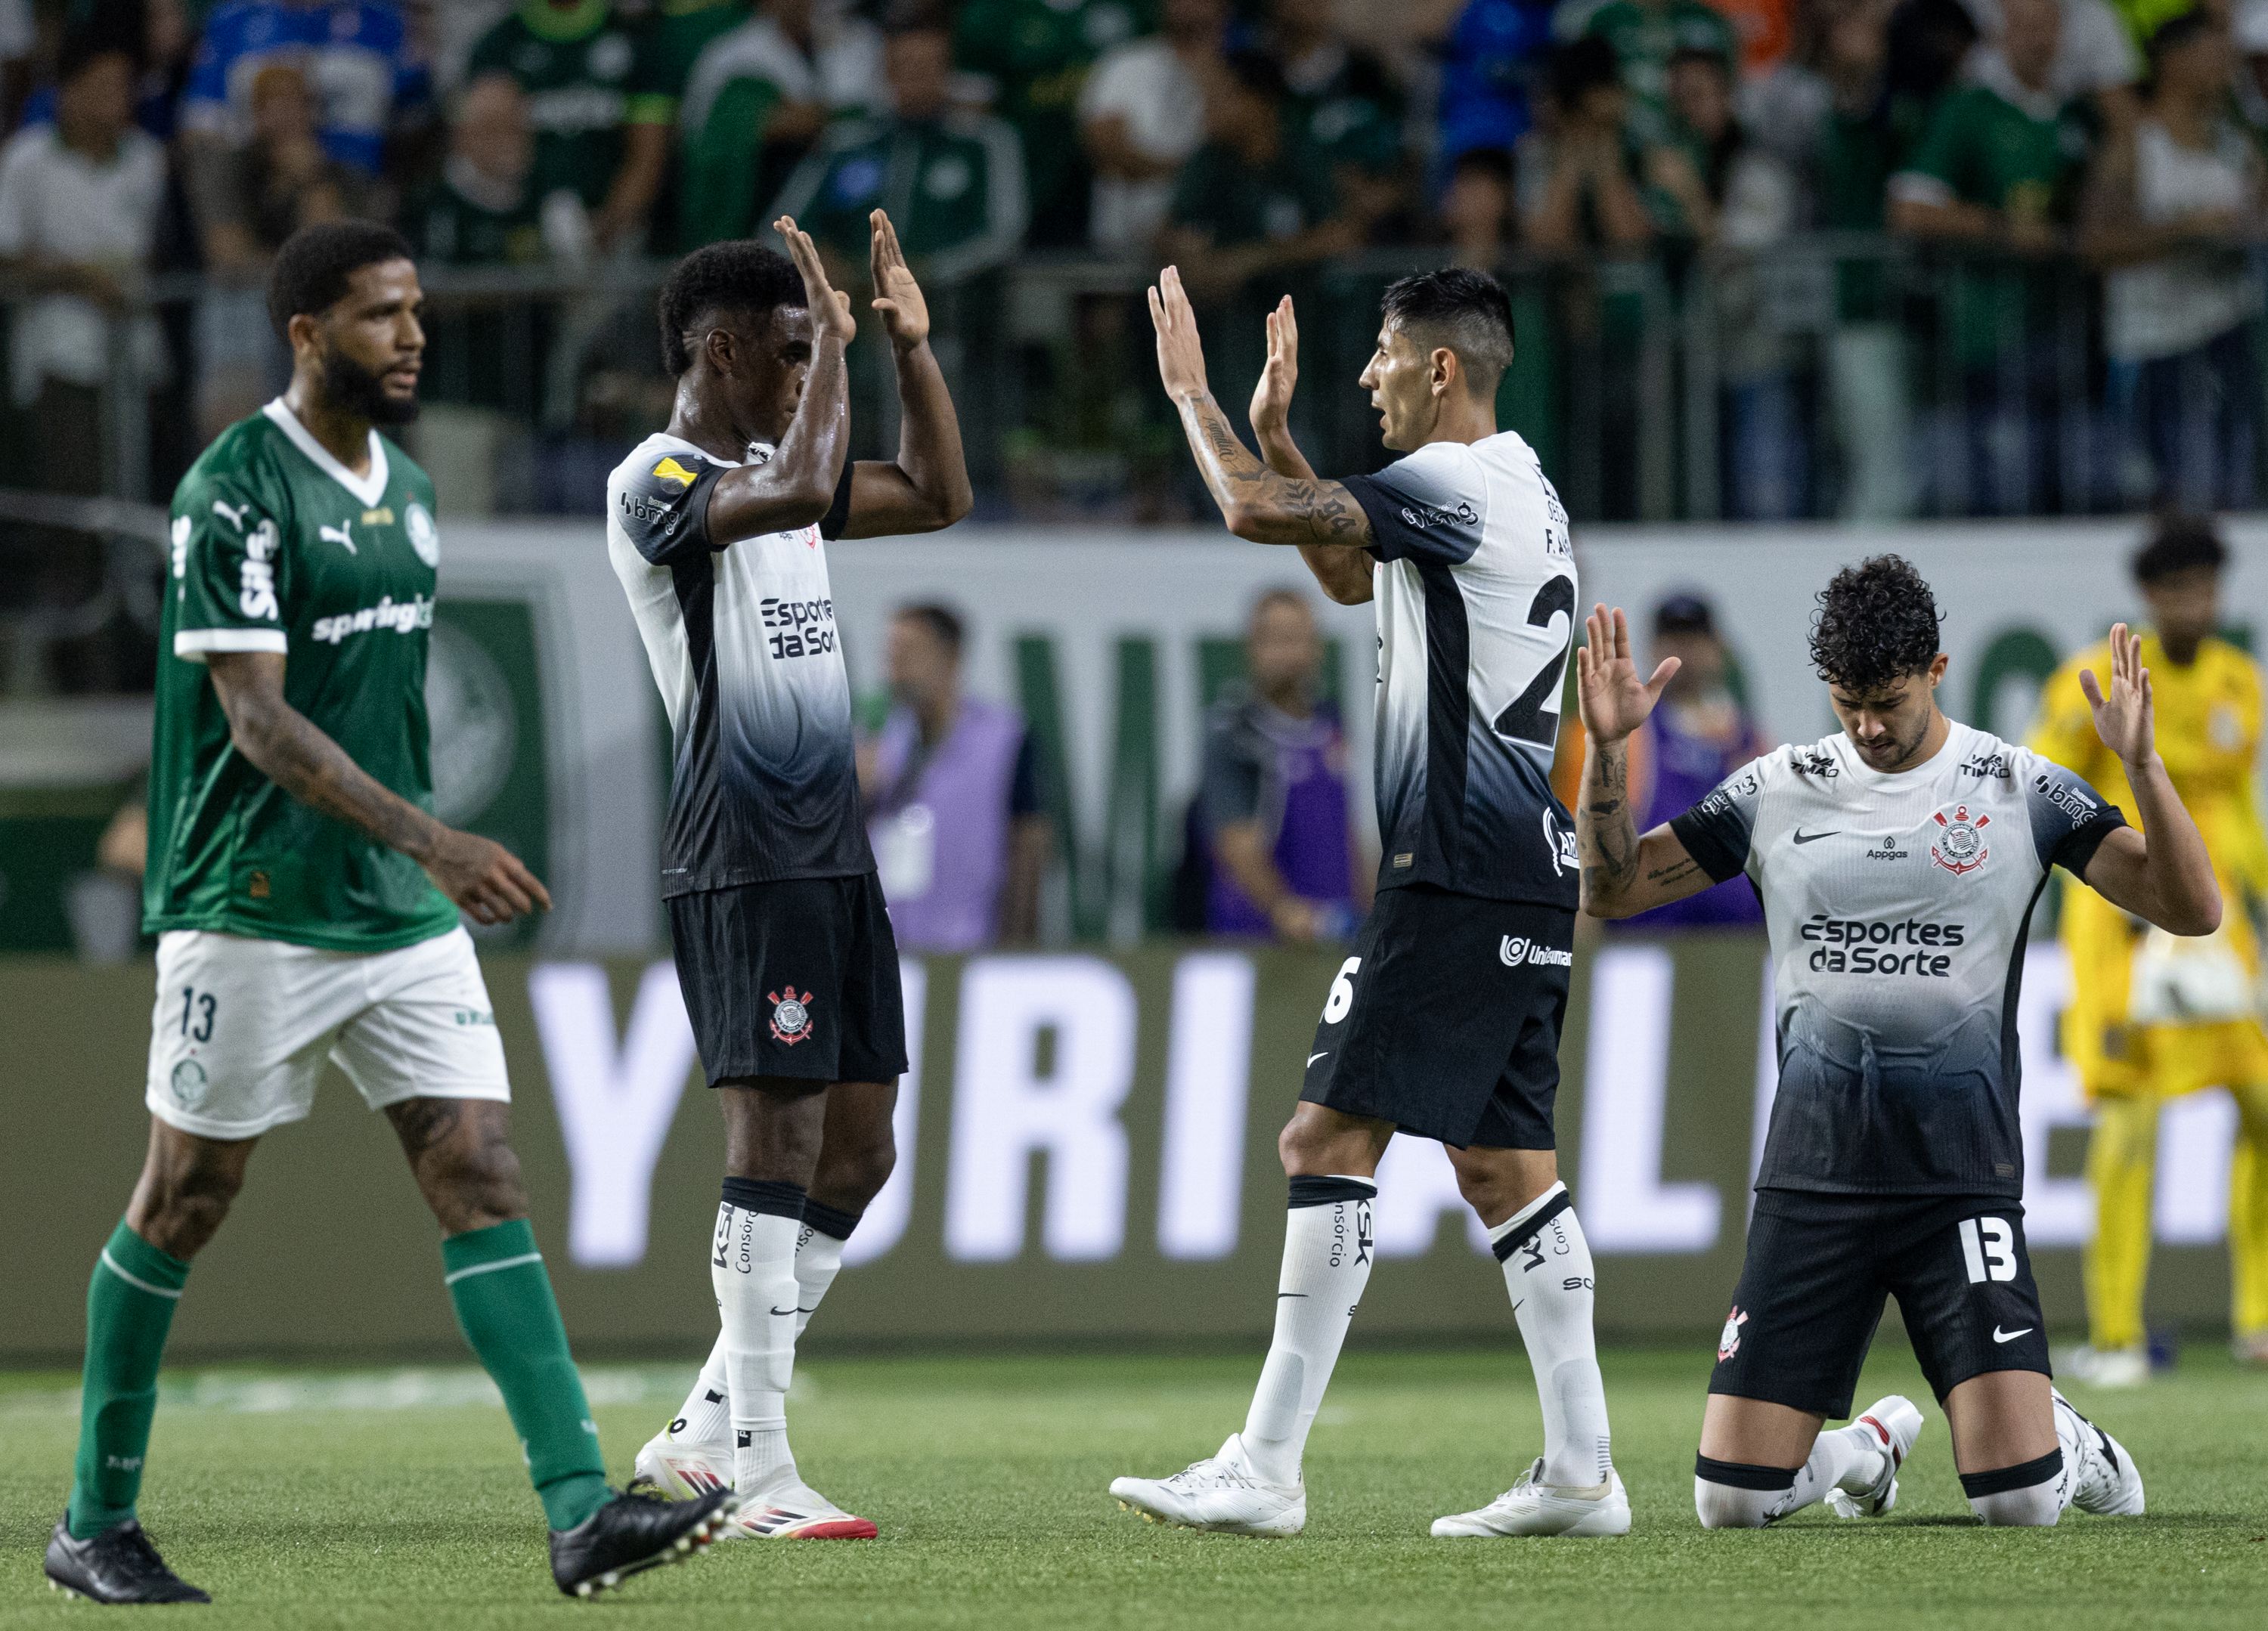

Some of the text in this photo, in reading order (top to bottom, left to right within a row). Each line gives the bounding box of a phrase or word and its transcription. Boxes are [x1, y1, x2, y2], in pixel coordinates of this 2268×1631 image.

[768, 631, 805, 660] da
[1492, 572, 1577, 751] 2
[1866, 849, 1908, 861] Appgas
[1800, 914, 1965, 951] Esportes
[1809, 945, 1951, 978] da Sorte
[181, 986, 218, 1044] 13
[1318, 956, 1362, 1025] 6
[1329, 1199, 1350, 1268] nsórcio
[1958, 1216, 2018, 1284] 13
